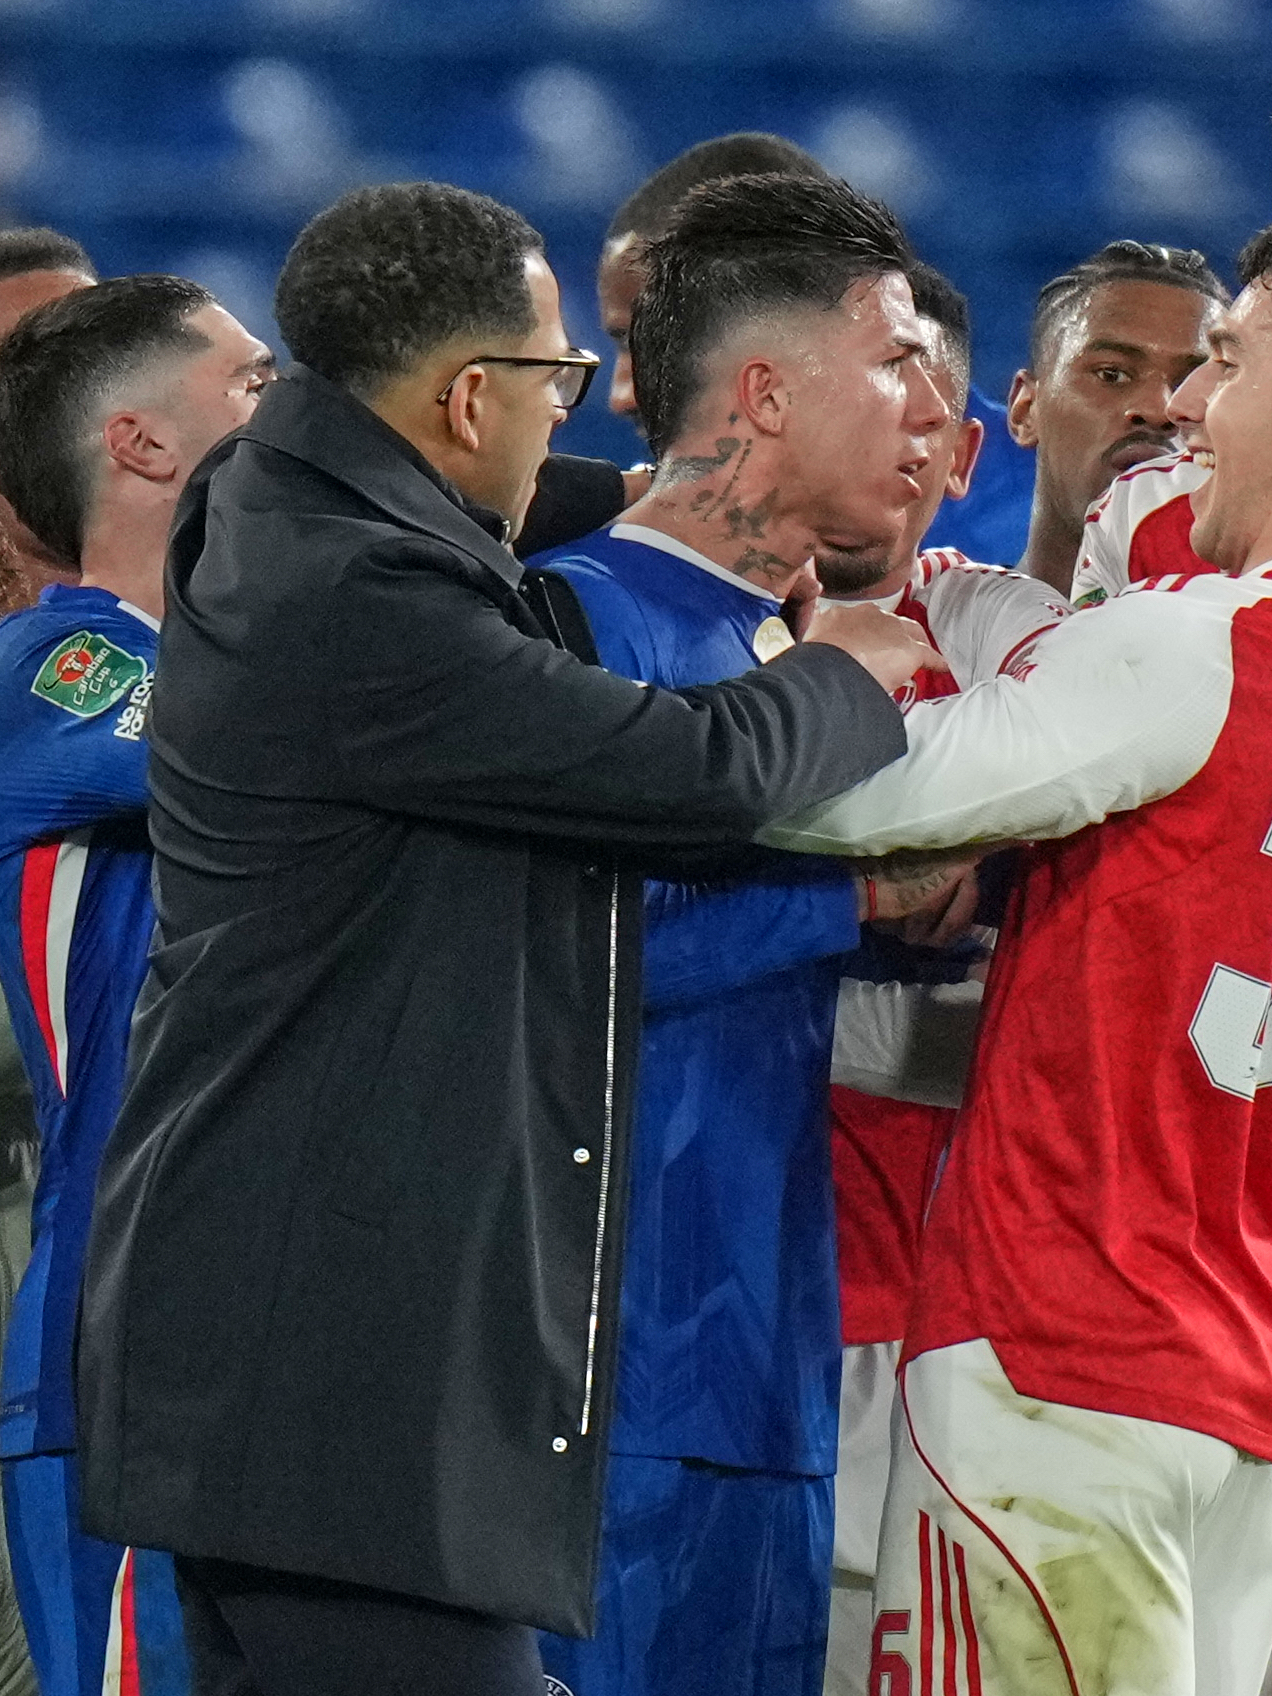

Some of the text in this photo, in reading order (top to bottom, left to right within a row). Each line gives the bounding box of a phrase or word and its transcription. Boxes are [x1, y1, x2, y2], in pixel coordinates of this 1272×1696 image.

[73, 647, 111, 706] Carabao
[89, 666, 111, 694] Cup
[113, 706, 136, 738] No
[129, 671, 155, 704] roo
